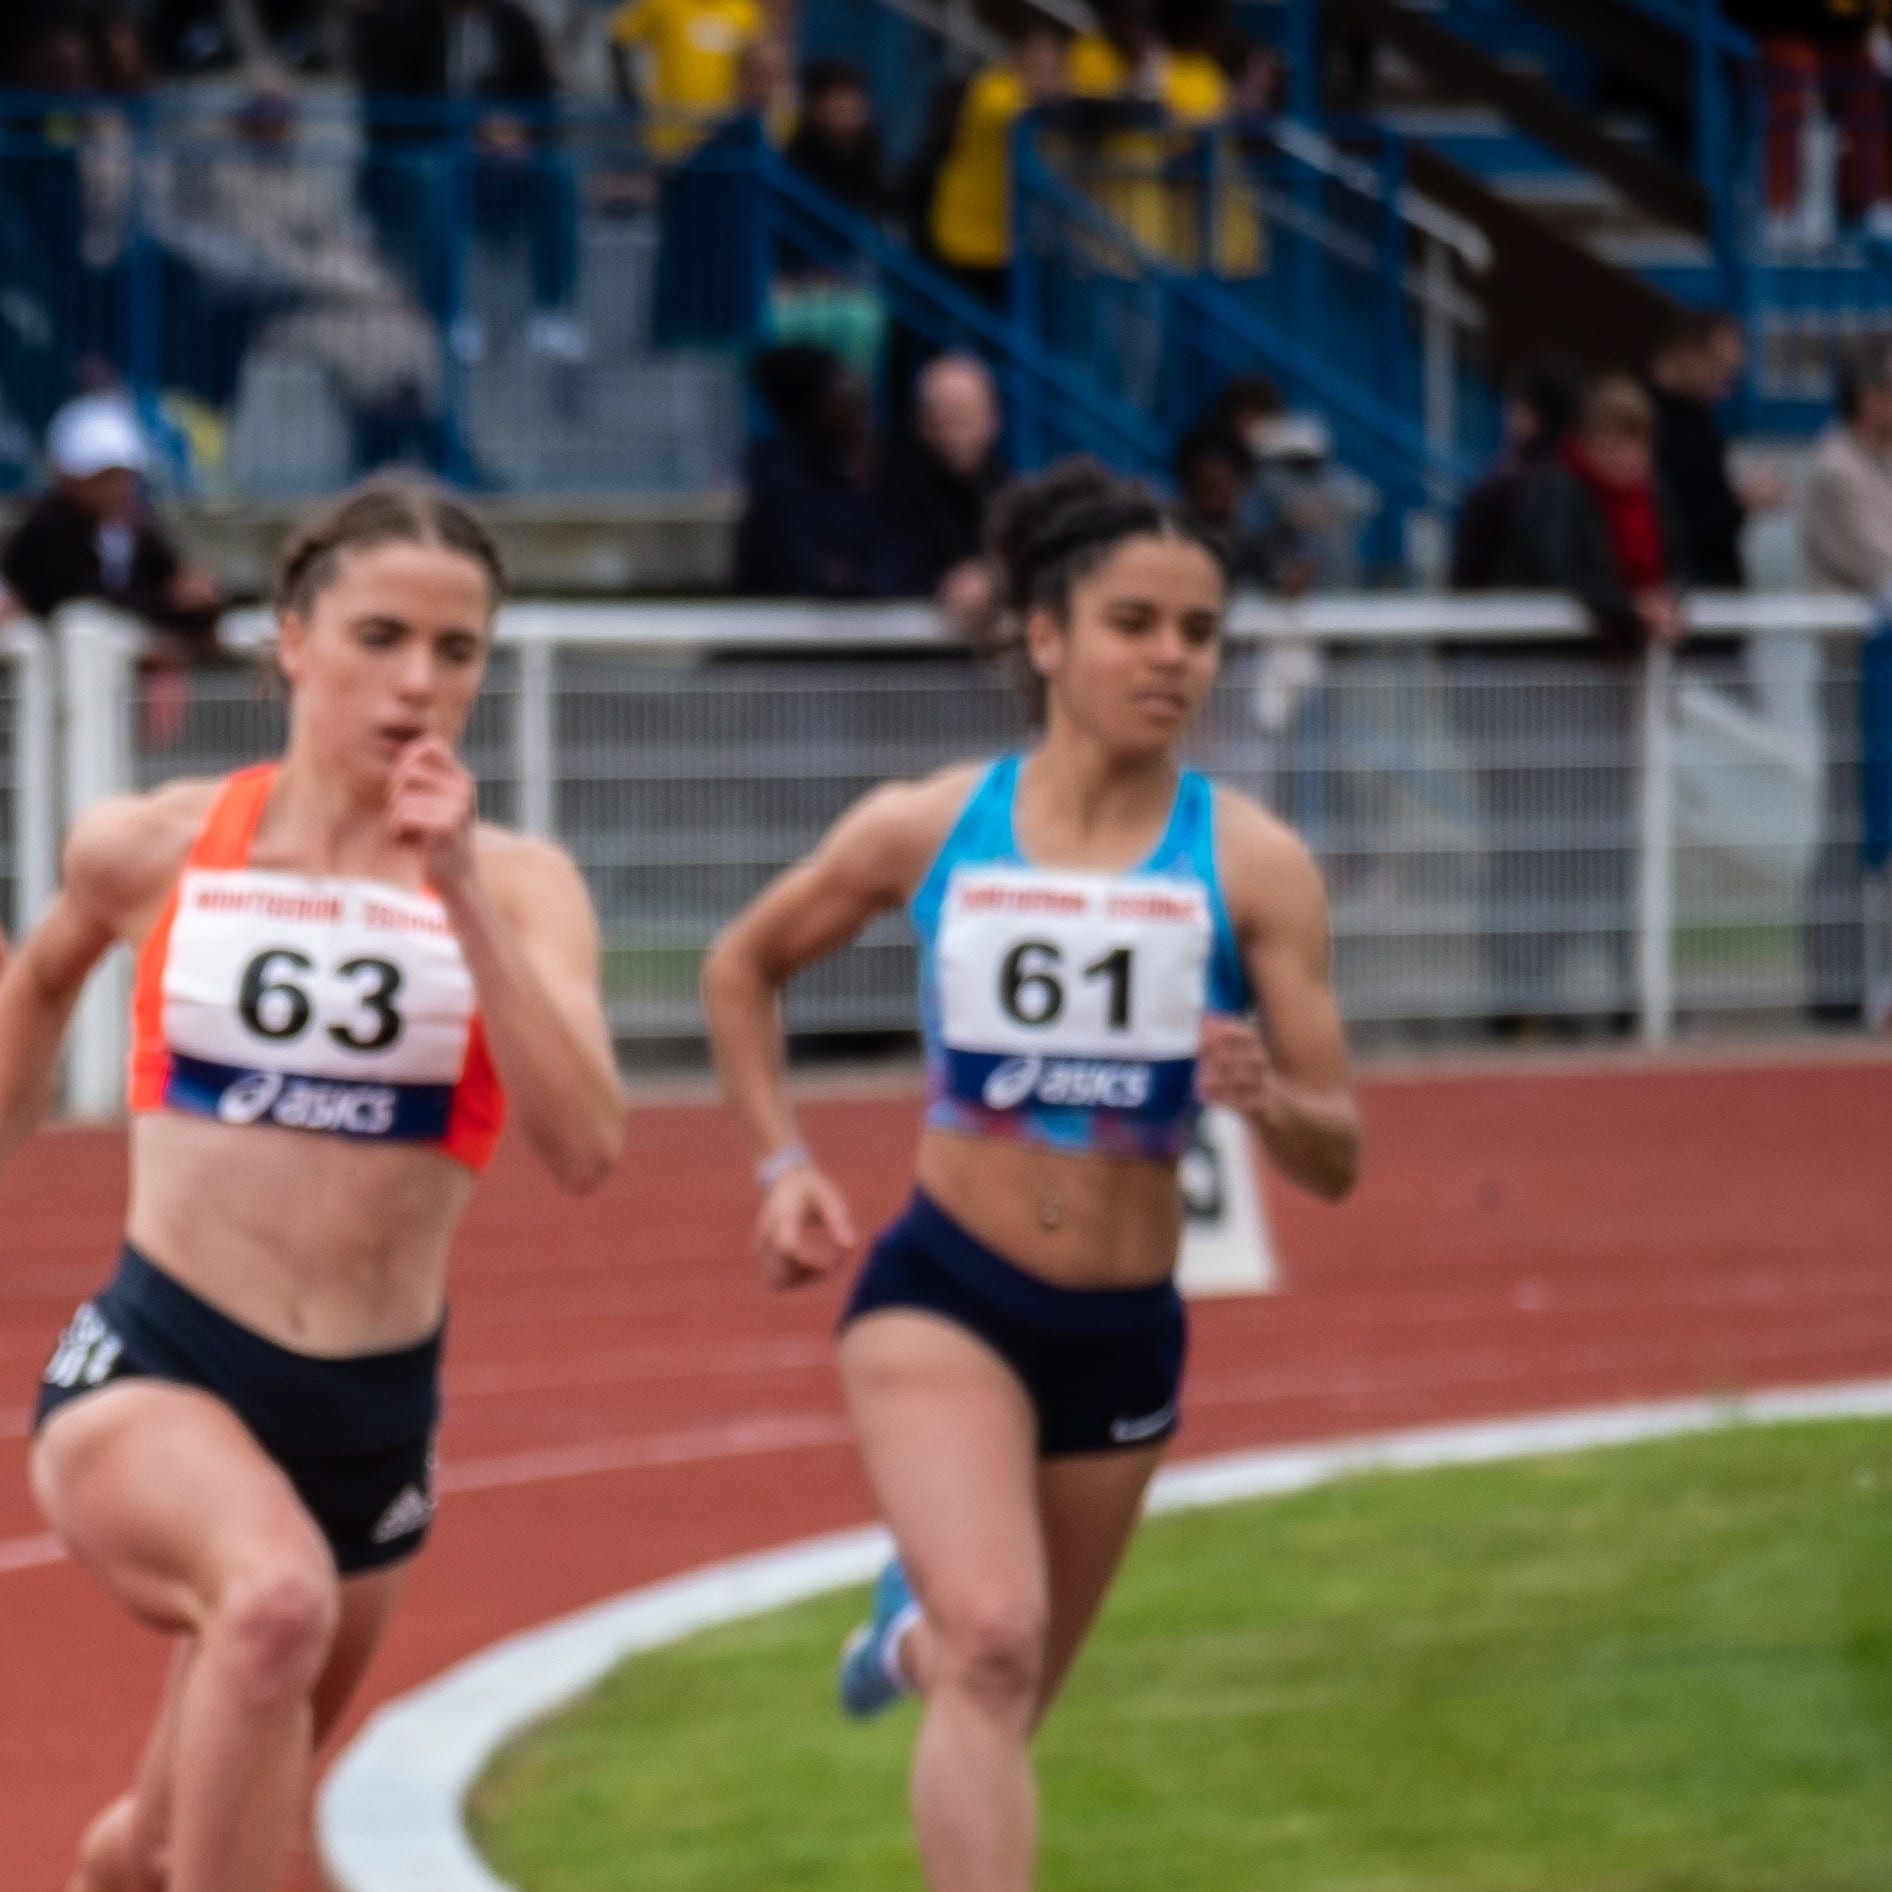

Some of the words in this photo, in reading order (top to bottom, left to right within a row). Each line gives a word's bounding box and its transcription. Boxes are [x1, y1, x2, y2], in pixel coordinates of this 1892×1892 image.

[238, 949, 404, 1053] 63
[999, 940, 1135, 1032] 61
[273, 1082, 398, 1134] asics
[1038, 1061, 1153, 1107] asics
